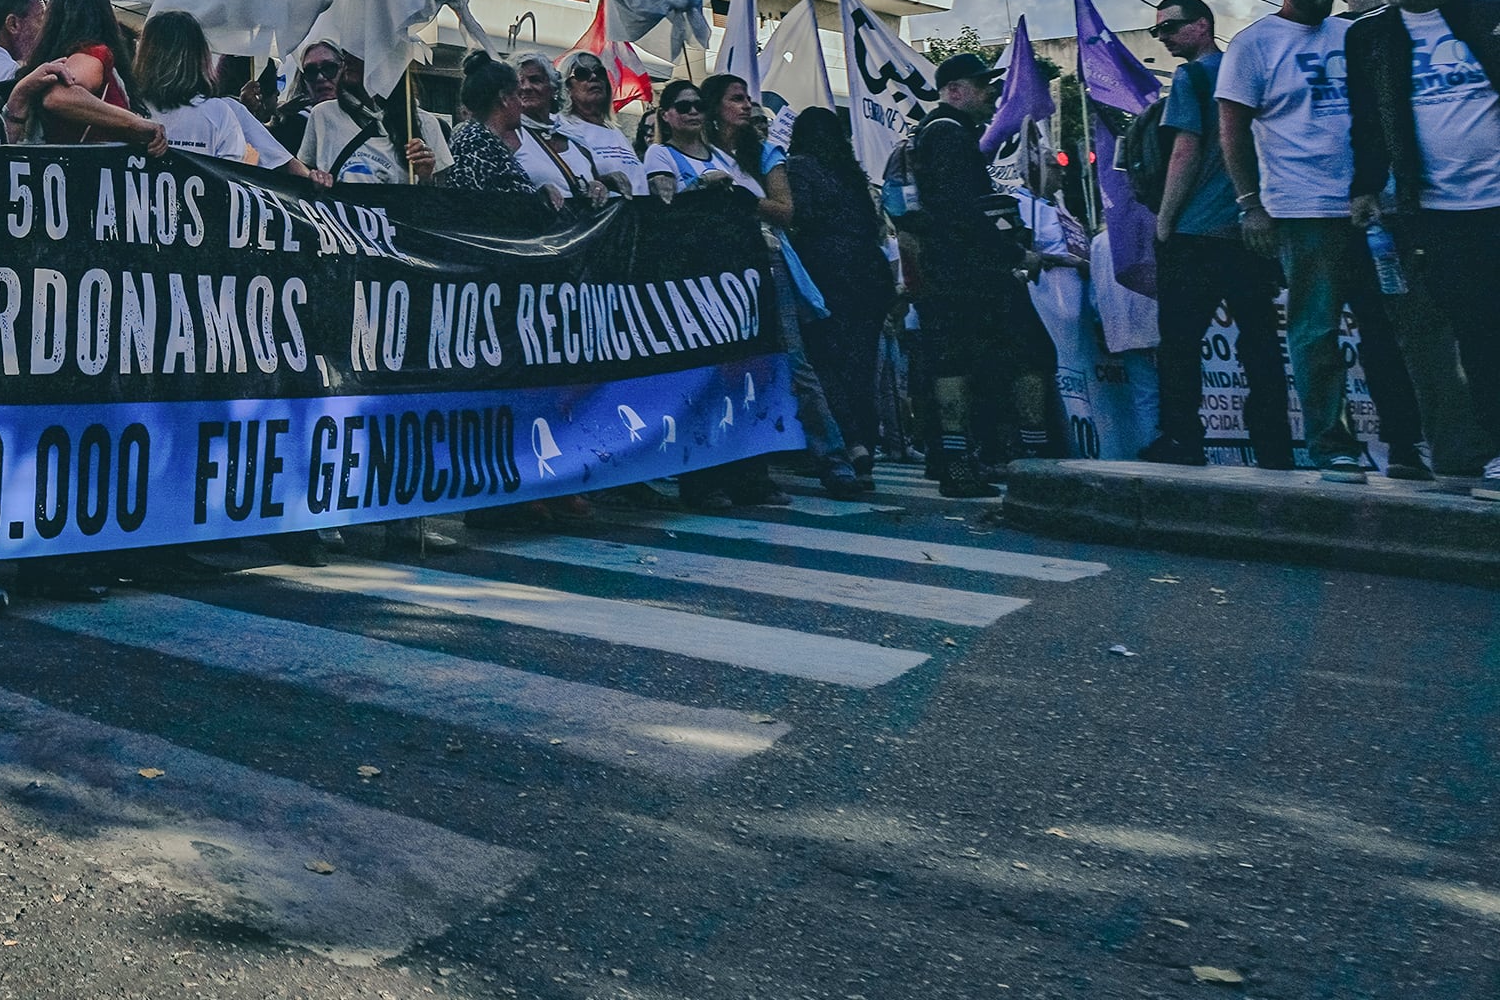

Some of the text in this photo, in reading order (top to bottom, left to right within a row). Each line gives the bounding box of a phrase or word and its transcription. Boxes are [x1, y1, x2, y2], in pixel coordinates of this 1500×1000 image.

[7, 159, 70, 241] 50
[95, 157, 206, 248] AÑOS
[228, 180, 300, 252] DEL
[299, 198, 412, 264] GOLPE
[350, 280, 409, 372] NO
[428, 282, 503, 369] NOS
[517, 267, 762, 366] RECONCILIAMOS
[193, 418, 290, 526] FUE
[306, 404, 522, 516] GENOCIDIO
